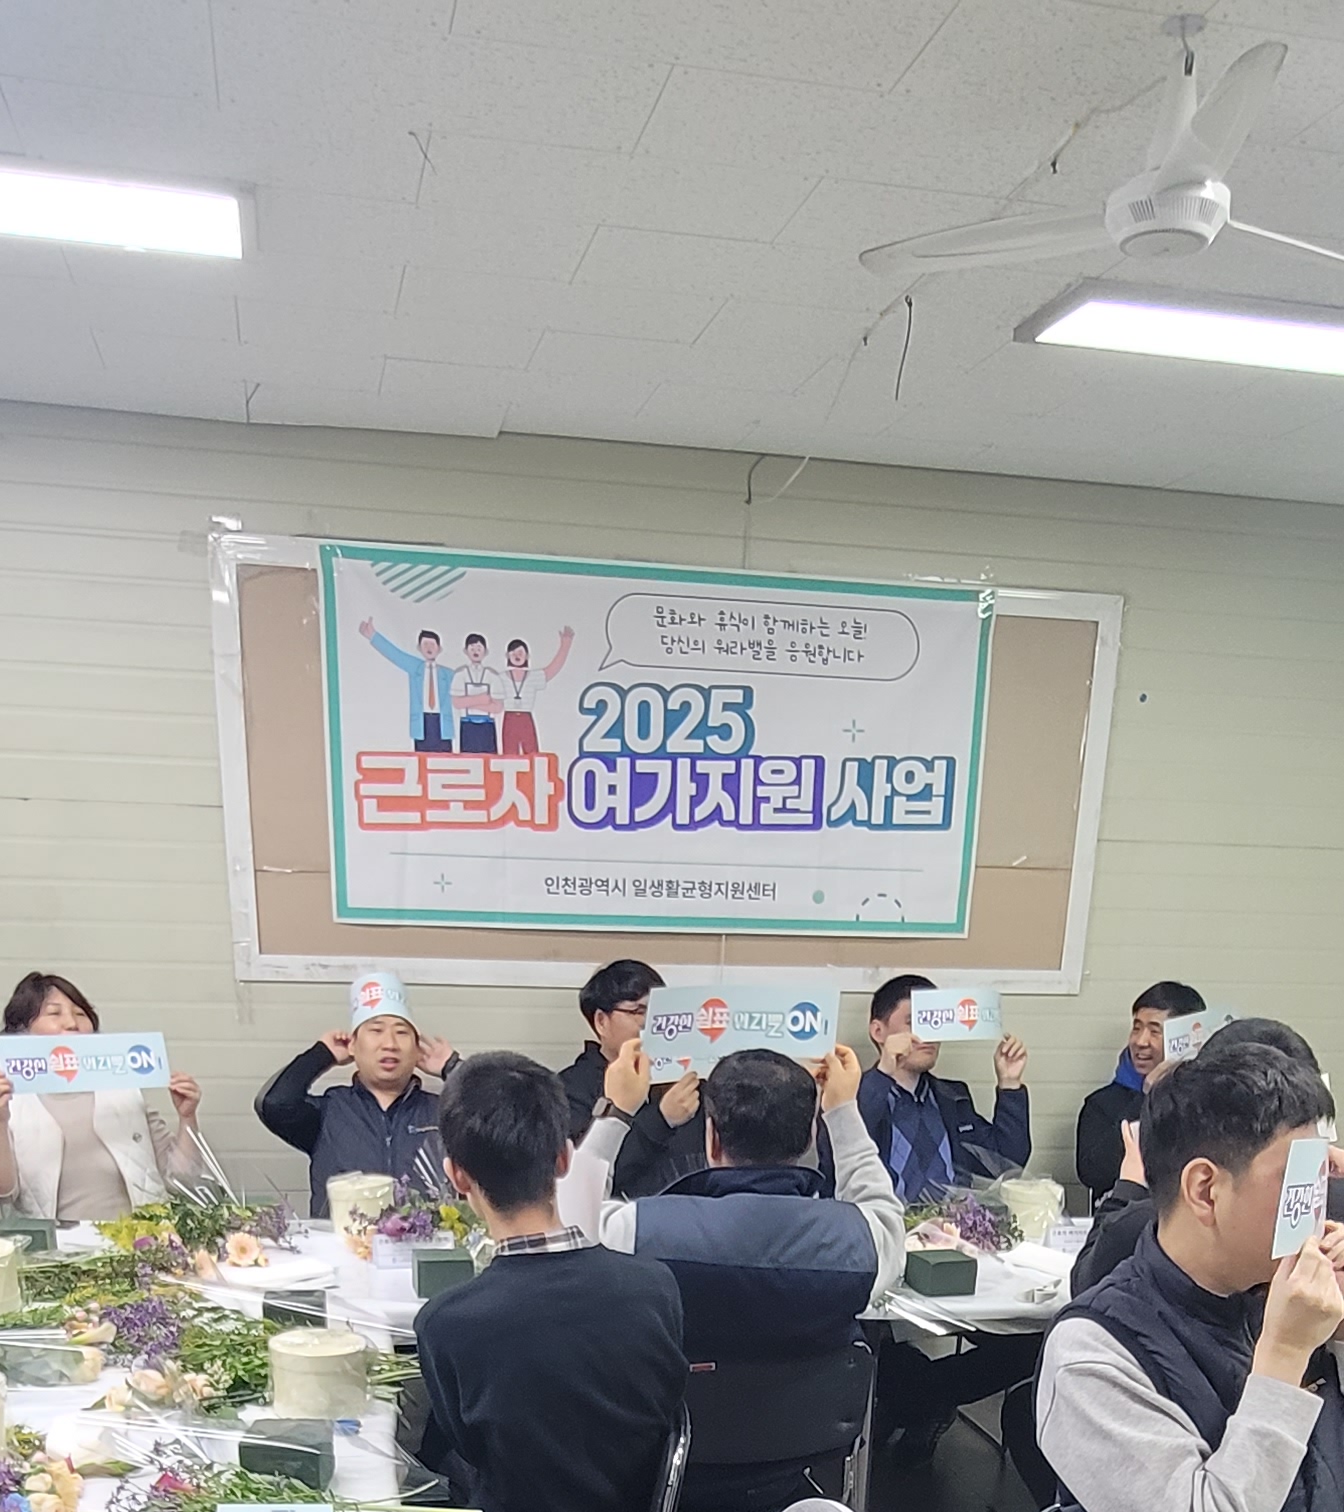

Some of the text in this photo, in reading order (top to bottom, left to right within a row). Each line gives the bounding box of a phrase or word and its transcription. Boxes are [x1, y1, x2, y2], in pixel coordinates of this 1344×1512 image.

[653, 606, 867, 640] 문화와 휴식이 함께하는 오늘!
[660, 635, 865, 666] 당신의 워라밸을 응원합니다
[581, 685, 750, 754] 2025
[359, 755, 950, 828] 근로자 여가지원 사업
[544, 875, 777, 901] 인천광역시 일생활균형지원센터
